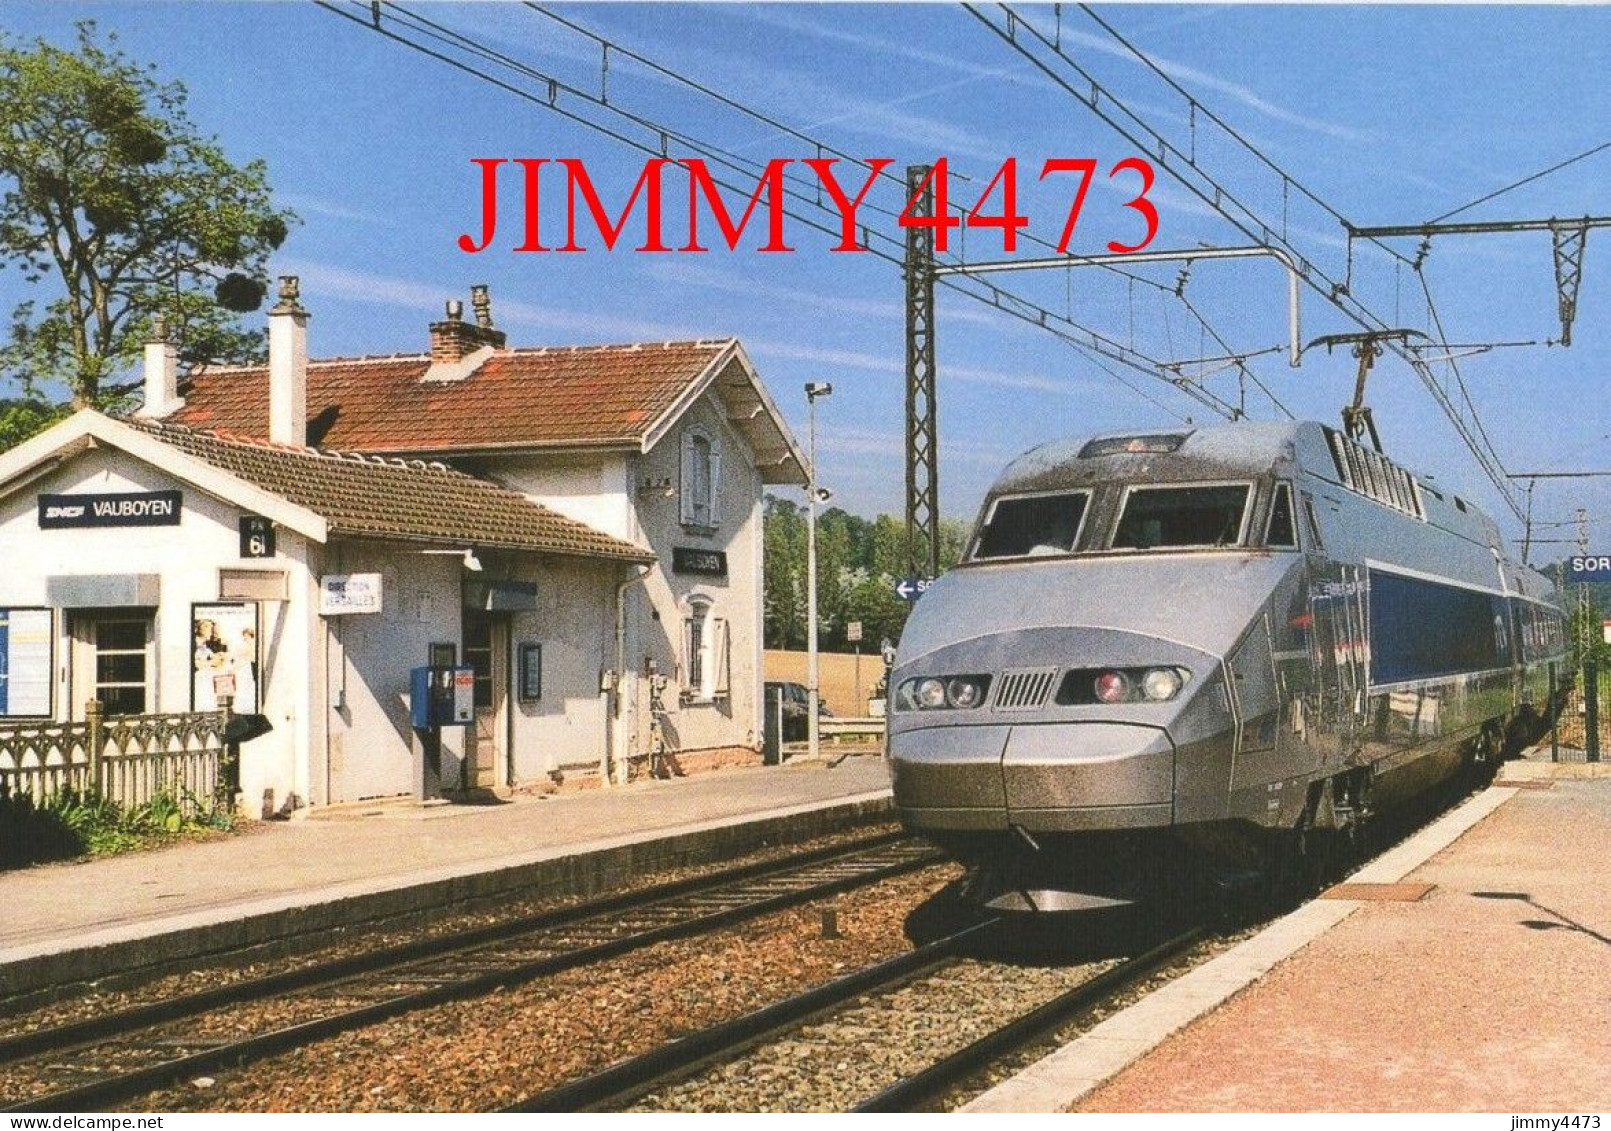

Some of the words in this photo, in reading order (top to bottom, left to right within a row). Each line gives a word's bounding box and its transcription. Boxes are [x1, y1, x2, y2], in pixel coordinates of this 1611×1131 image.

[93, 500, 172, 517] VAUBOYEN
[250, 534, 266, 554] 61
[1573, 557, 1611, 572] SOR
